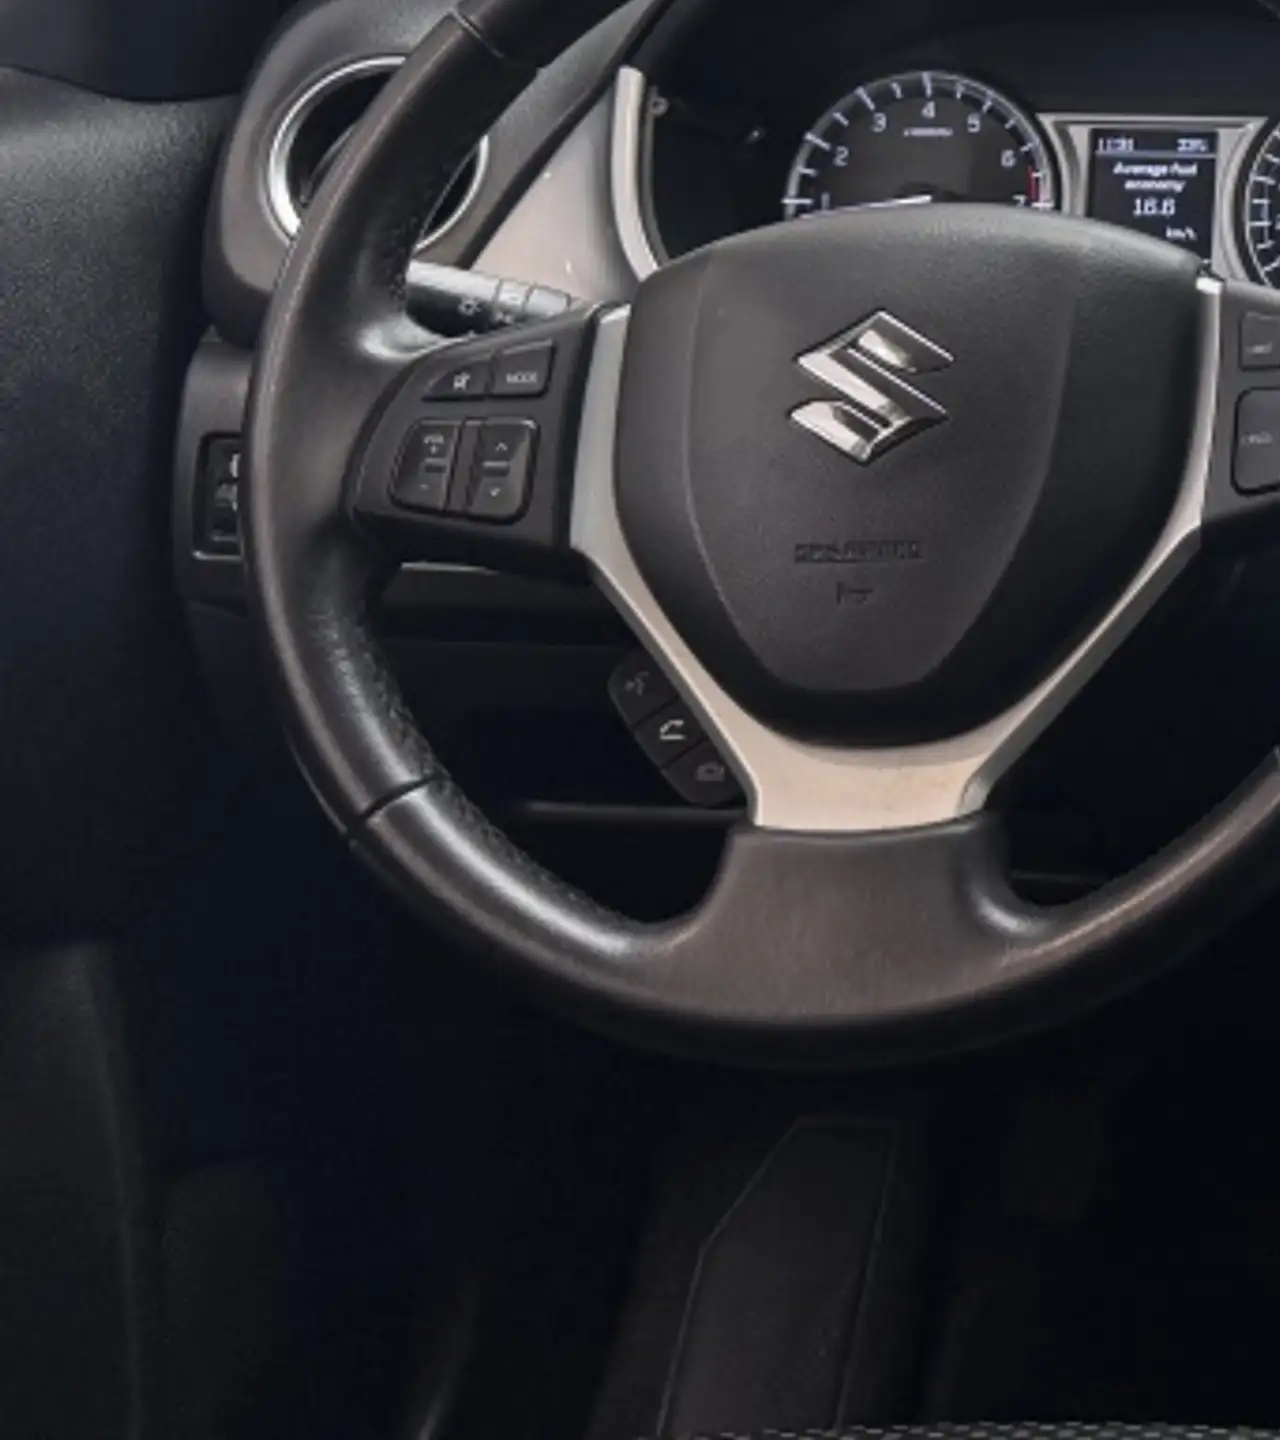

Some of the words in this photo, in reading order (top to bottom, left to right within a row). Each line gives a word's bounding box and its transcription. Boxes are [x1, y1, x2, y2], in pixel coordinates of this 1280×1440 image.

[921, 101, 936, 119] 4
[872, 113, 887, 132] 3
[967, 113, 981, 133] 5
[833, 145, 849, 166] 2
[1001, 149, 1017, 169] 6
